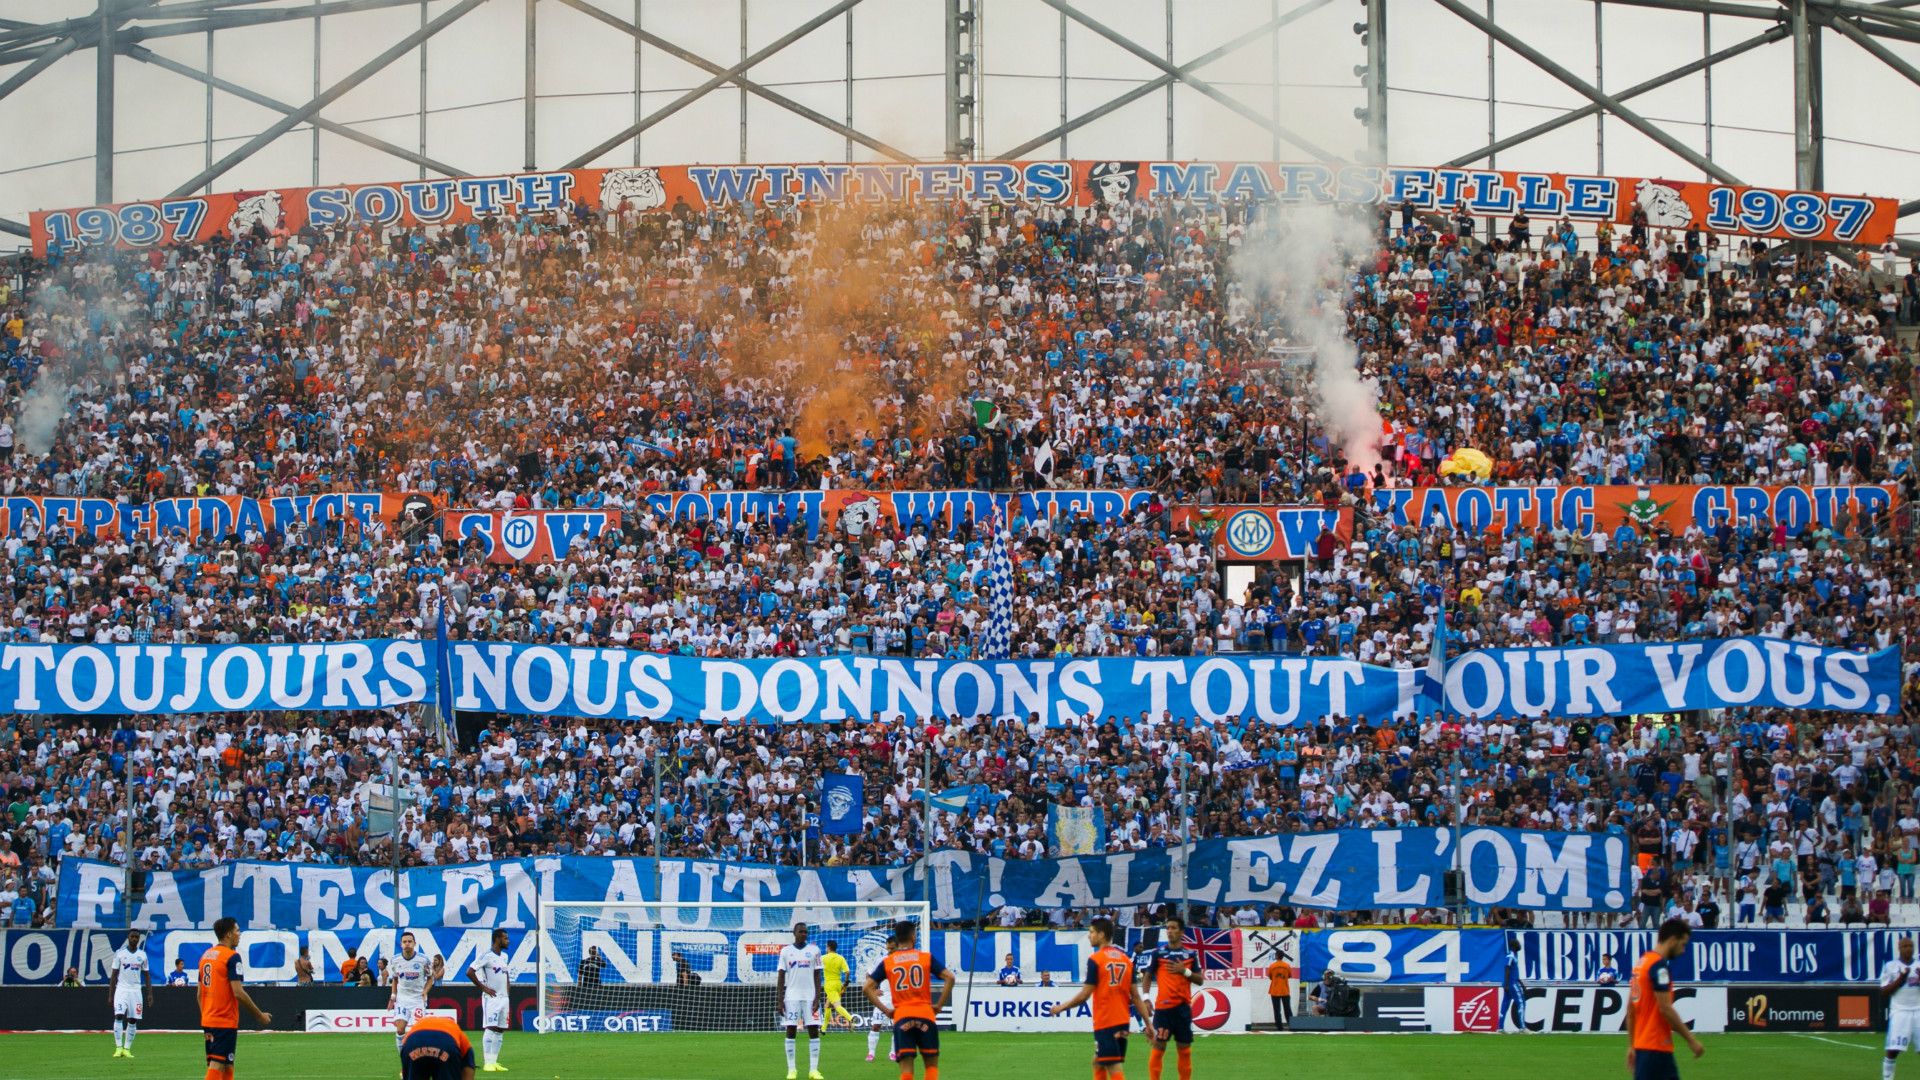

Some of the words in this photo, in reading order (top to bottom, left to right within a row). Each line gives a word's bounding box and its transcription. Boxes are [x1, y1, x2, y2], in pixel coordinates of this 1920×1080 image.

[44, 199, 209, 250] 1987
[306, 172, 576, 228] SOUTH
[687, 162, 1073, 206] WINNERS
[1149, 163, 1619, 221] MARSEILLE
[1705, 186, 1875, 240] 1987
[0, 492, 383, 545] DEPENDANCE
[645, 490, 825, 543] SOUTH
[890, 490, 1152, 542] WINNERS
[1277, 508, 1341, 558] W
[1372, 486, 1595, 540] KAOTIC
[1692, 485, 1892, 540] GROUP
[2, 642, 427, 711] TOUJOURS
[455, 644, 672, 720] NOUS
[701, 658, 1105, 724] DONNONS
[1131, 657, 1365, 726] TOUT
[1645, 637, 1891, 712] VOUS,
[72, 857, 561, 931] FAITES-EN
[1039, 833, 1341, 909] ALLEZ
[1374, 827, 1626, 910] L'OM!
[203, 963, 211, 986] 8
[893, 964, 923, 991] 20
[1106, 962, 1127, 986] 17
[1327, 931, 1470, 982] 84
[1692, 941, 1756, 981] pour
[1780, 932, 1818, 974] les
[604, 1015, 661, 1031] ONET
[1511, 986, 1697, 1032] CEPC
[1733, 1008, 1745, 1021] le
[1746, 994, 1768, 1027] 12
[1769, 1008, 1824, 1021] homme
[1840, 1018, 1867, 1026] orange
